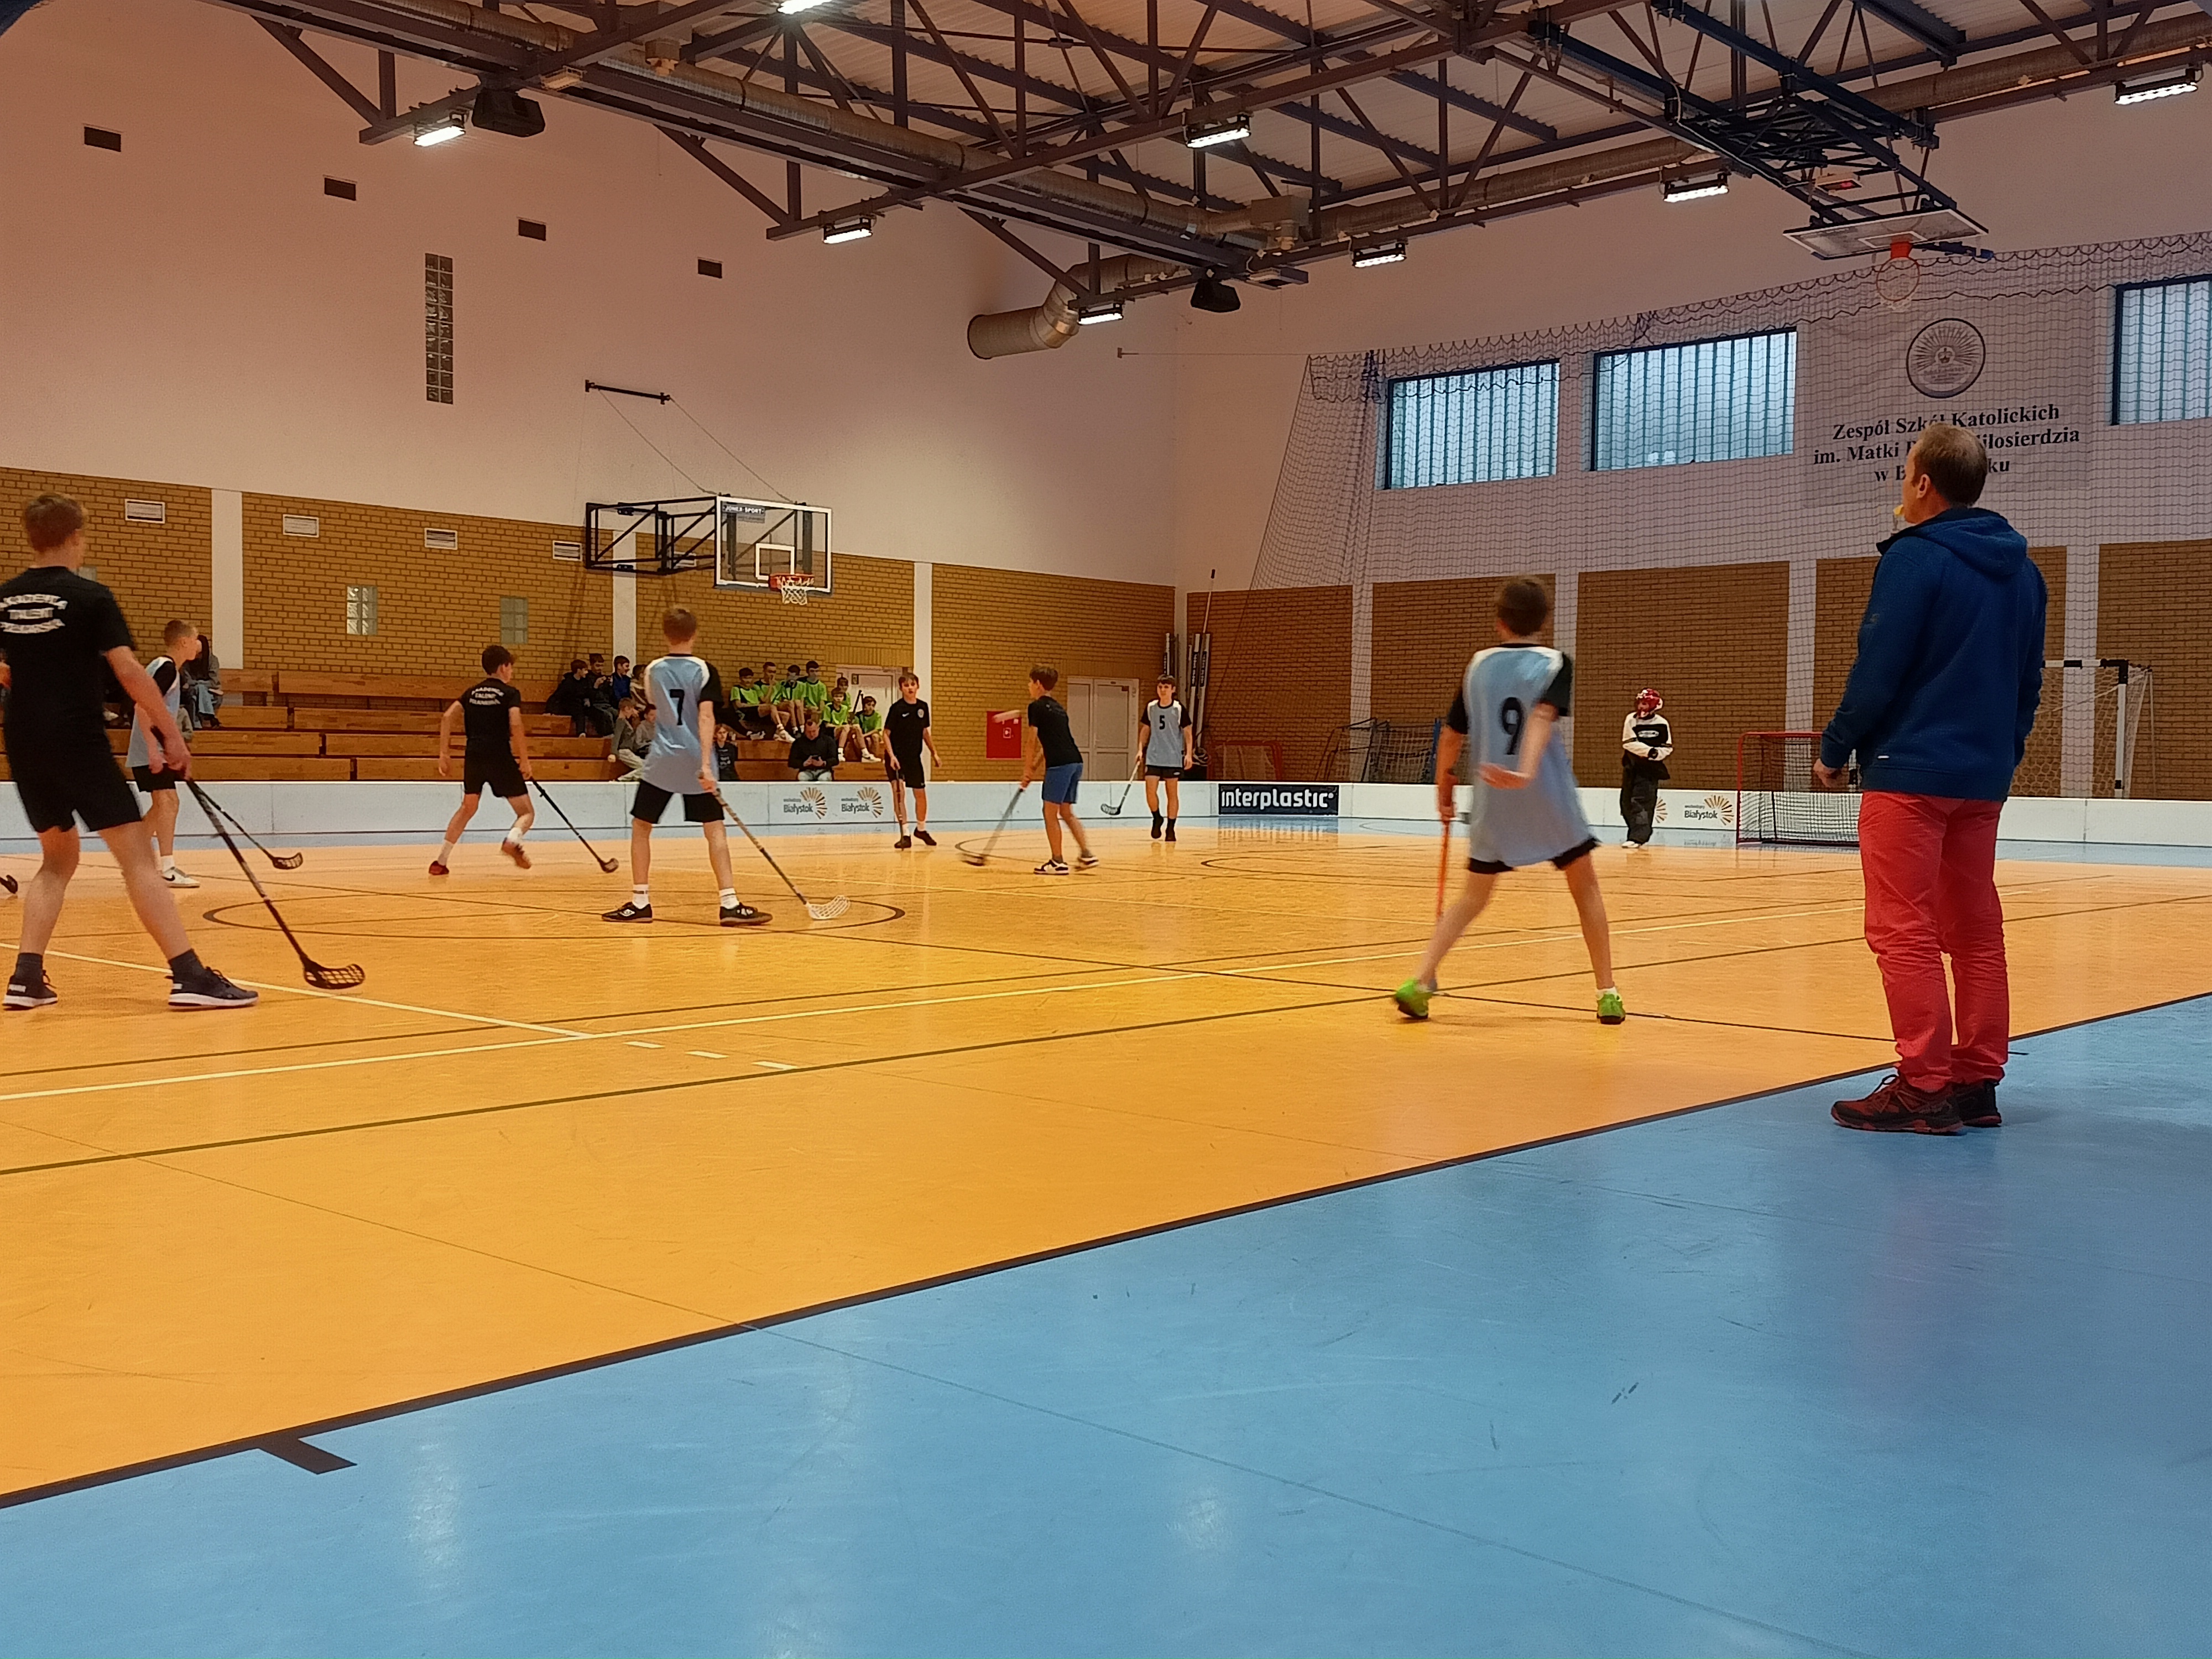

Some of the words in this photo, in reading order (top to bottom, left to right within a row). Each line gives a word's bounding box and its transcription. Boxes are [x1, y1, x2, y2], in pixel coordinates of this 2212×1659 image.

[1833, 419, 1890, 441] Zespół
[1952, 404, 2059, 427] Katolickich
[1813, 450, 1841, 465] im.
[1846, 442, 1900, 462] Matki
[1976, 427, 2080, 449] iłosierdzia
[1875, 471, 1888, 482] w
[669, 688, 685, 726] 7
[1159, 715, 1165, 730] 5
[1501, 697, 1524, 755] 9
[841, 802, 870, 814] Białystok
[1221, 788, 1328, 810] interplastic
[783, 803, 813, 815] Białystok
[1684, 810, 1718, 821] Białystok
